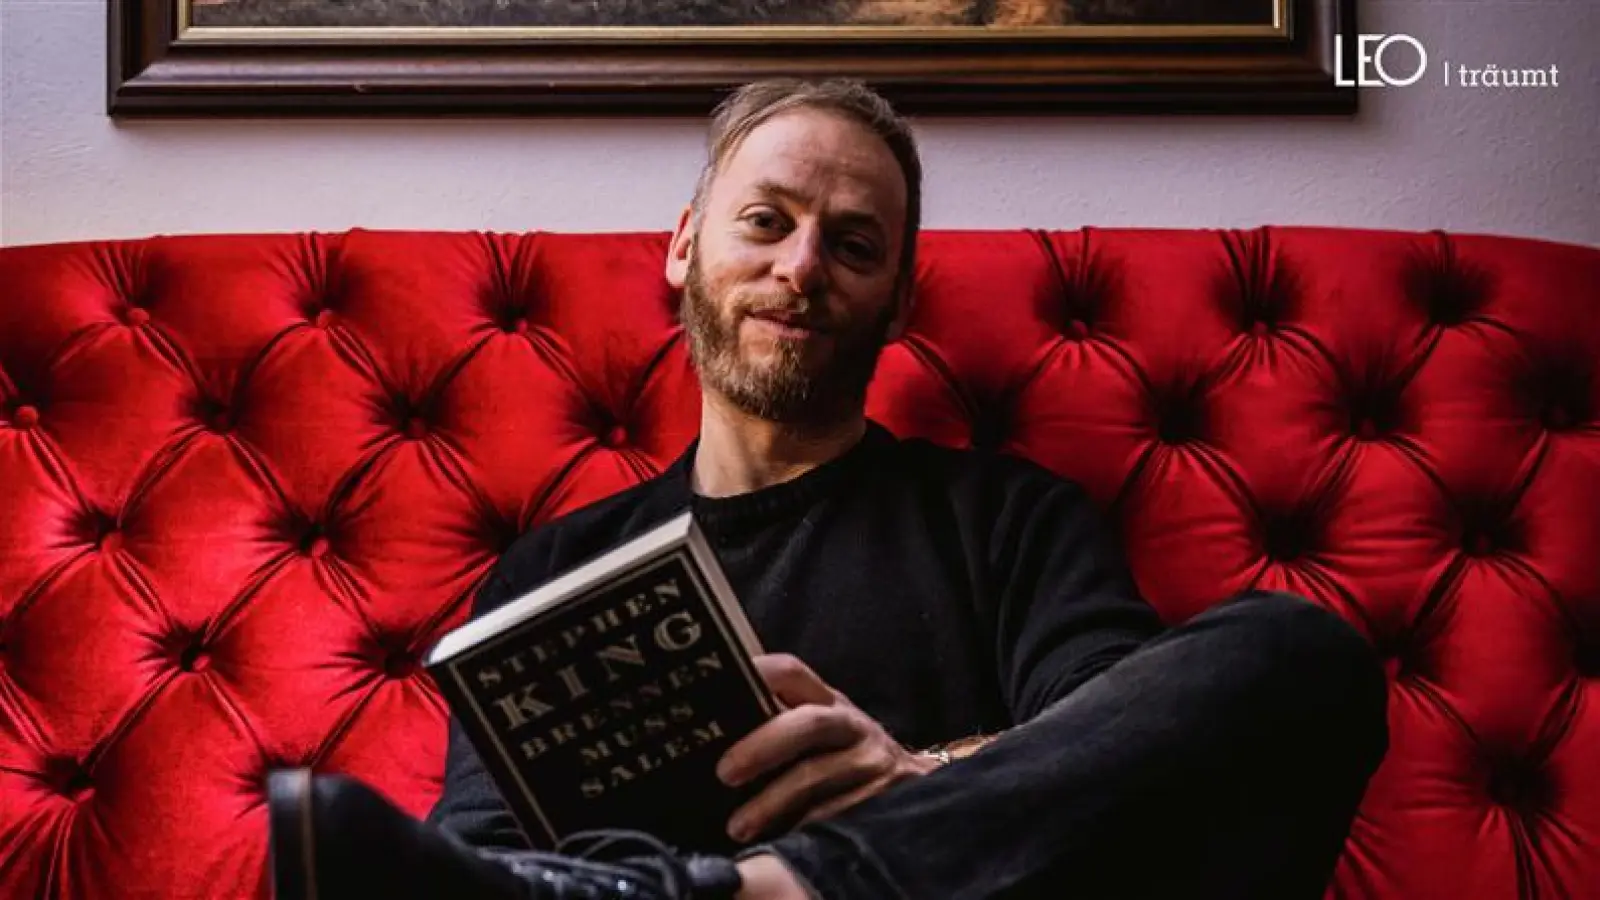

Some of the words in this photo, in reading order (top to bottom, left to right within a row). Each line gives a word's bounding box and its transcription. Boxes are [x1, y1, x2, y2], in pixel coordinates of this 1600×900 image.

[477, 578, 681, 688] STEPHEN
[496, 611, 701, 731] KING
[520, 651, 723, 760] BRENNEN
[580, 719, 726, 799] SALEM
[581, 704, 694, 766] MUSS
